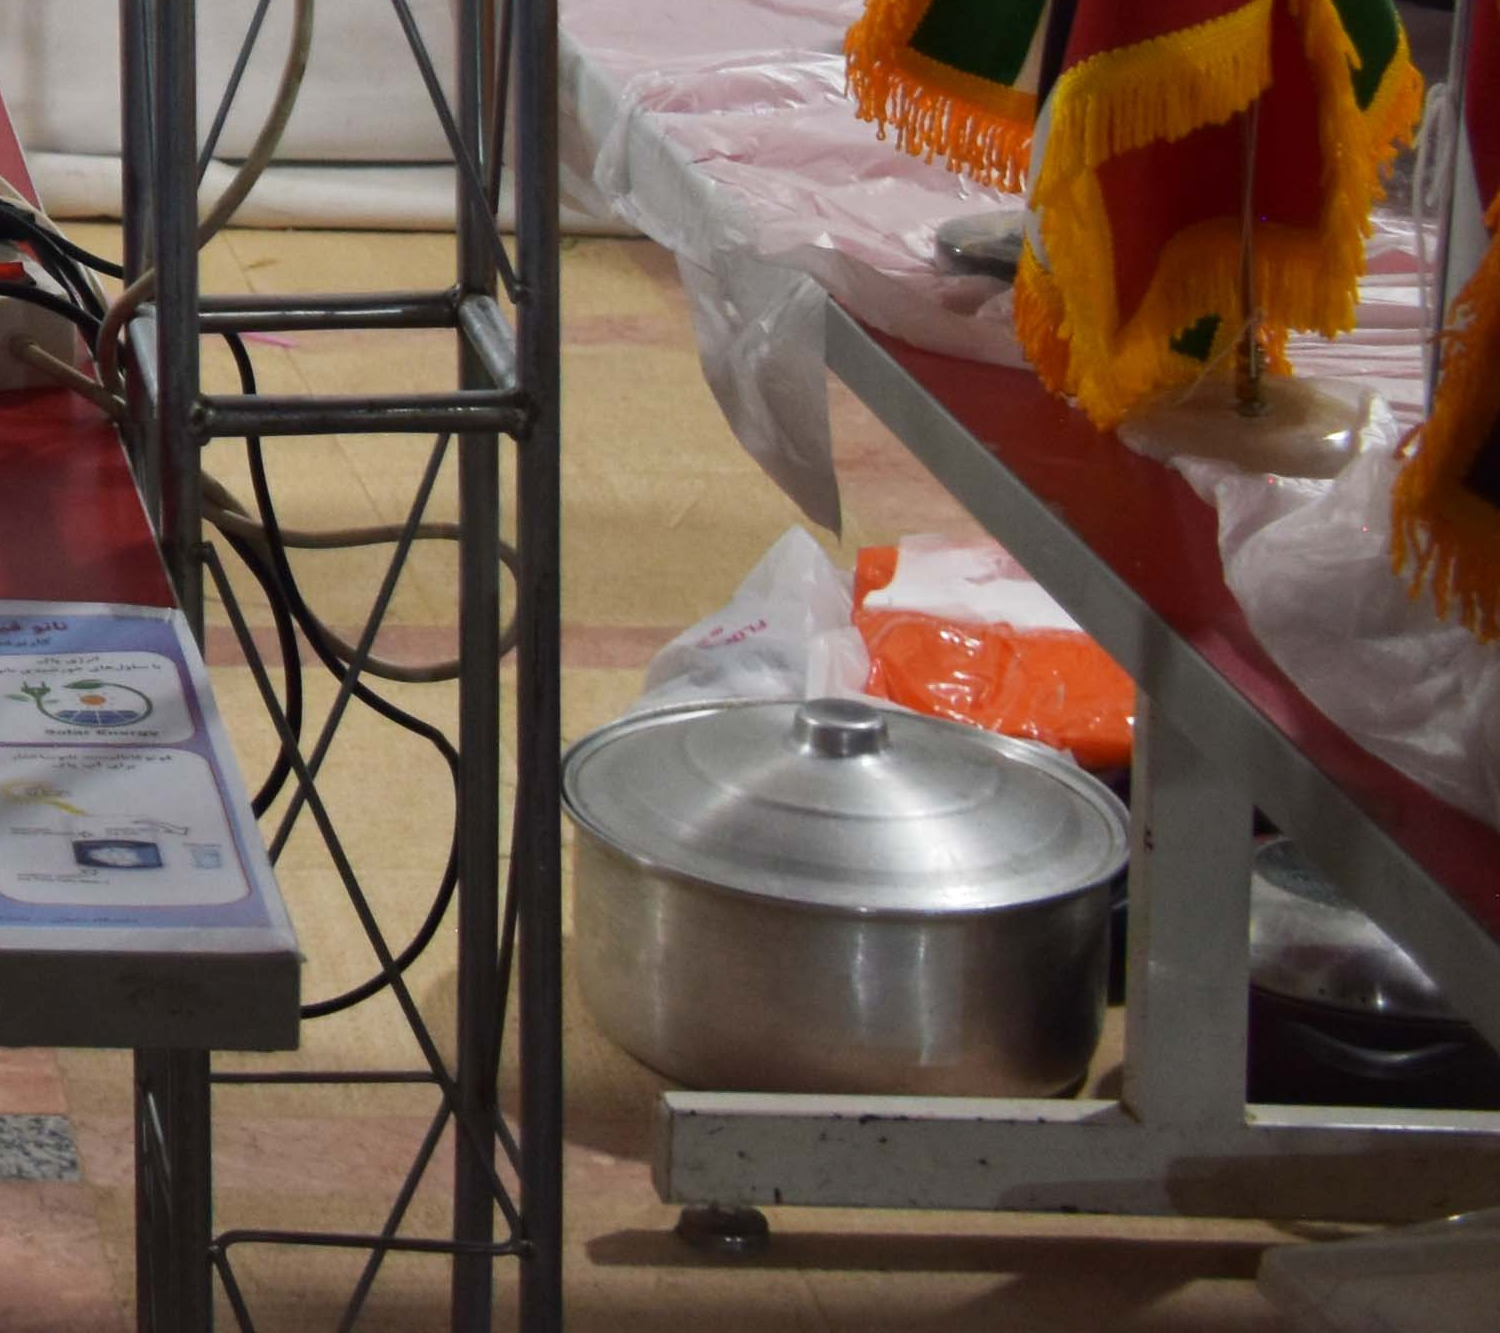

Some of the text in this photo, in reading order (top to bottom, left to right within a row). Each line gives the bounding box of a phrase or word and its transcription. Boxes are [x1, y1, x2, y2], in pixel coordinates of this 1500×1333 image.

[31, 621, 68, 635] نانو
[44, 728, 160, 737] Solar Energy
